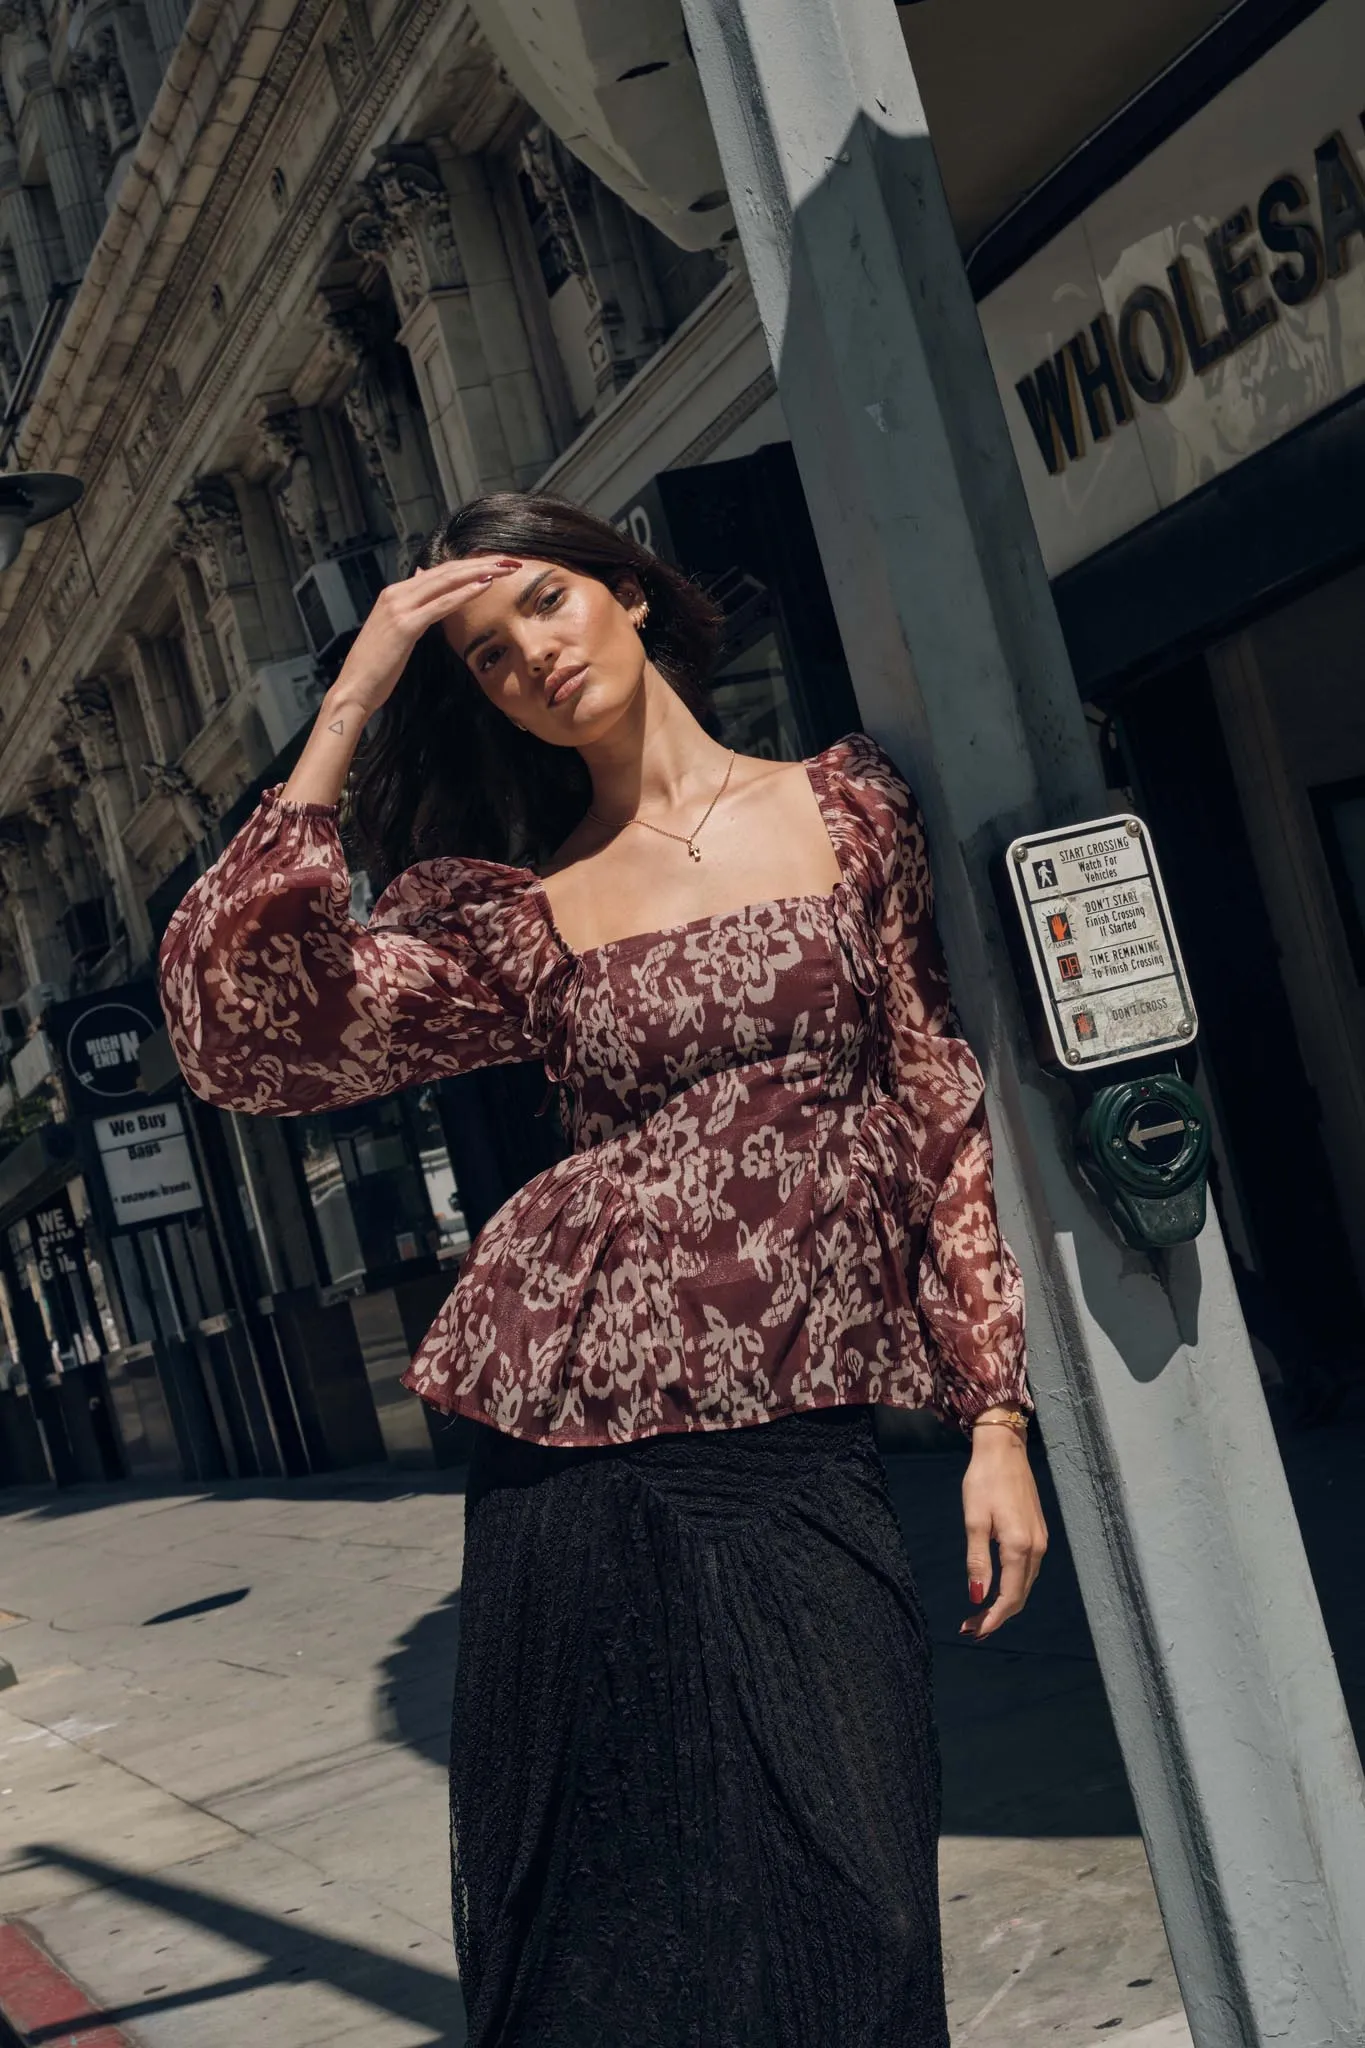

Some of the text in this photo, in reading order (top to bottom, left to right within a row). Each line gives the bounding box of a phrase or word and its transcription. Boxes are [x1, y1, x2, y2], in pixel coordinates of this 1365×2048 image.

[1015, 110, 1365, 476] WHOLESA
[1059, 836, 1129, 862] START CROSSING
[1078, 855, 1118, 872] Watch For
[1084, 868, 1118, 883] Vehicles
[1084, 891, 1138, 913] DON'T START
[1085, 906, 1146, 928] Finish Crossing
[1100, 920, 1137, 936] If Started
[1089, 940, 1161, 966] TIME REMAINING
[1092, 955, 1165, 979] To Finish Crossing
[1112, 997, 1168, 1021] DON'T CROSS
[85, 1034, 121, 1056] HIGH
[92, 1050, 121, 1069] END
[108, 1112, 167, 1137] We Buy
[35, 1207, 67, 1235] WE
